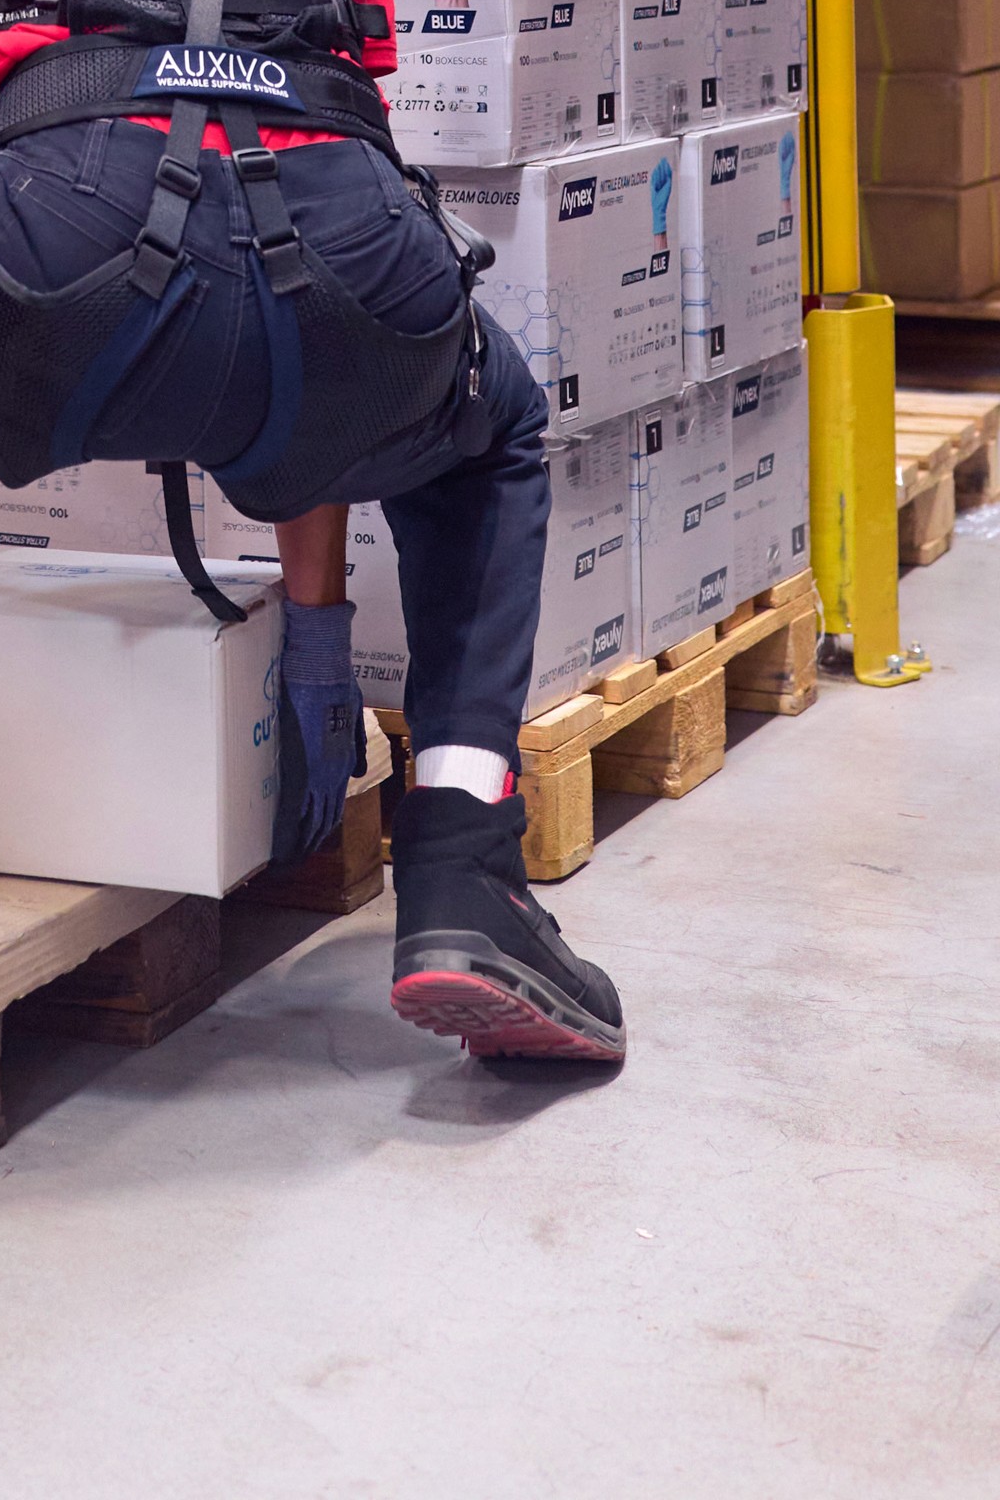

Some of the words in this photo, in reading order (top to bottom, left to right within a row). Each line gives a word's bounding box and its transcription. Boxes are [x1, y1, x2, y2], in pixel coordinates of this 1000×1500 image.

[431, 15, 465, 29] BLUE
[554, 8, 570, 23] BLUE
[420, 54, 433, 64] 10
[435, 56, 488, 66] BOXES/CASE
[519, 55, 530, 66] 100
[156, 50, 286, 88] AUXIVO
[157, 77, 209, 88] WEARABLE
[211, 79, 252, 90] SUPPORT
[254, 84, 289, 98] SYSTEMS
[405, 100, 430, 111] 2777
[445, 190, 476, 203] EXAM
[477, 190, 520, 205] GLOVES
[653, 257, 666, 271] BLUE
[50, 508, 68, 519] 100
[222, 522, 272, 534] BOXES/CASE
[355, 533, 376, 544] 100
[578, 554, 593, 573] BLUE
[362, 665, 403, 682] NITRILE
